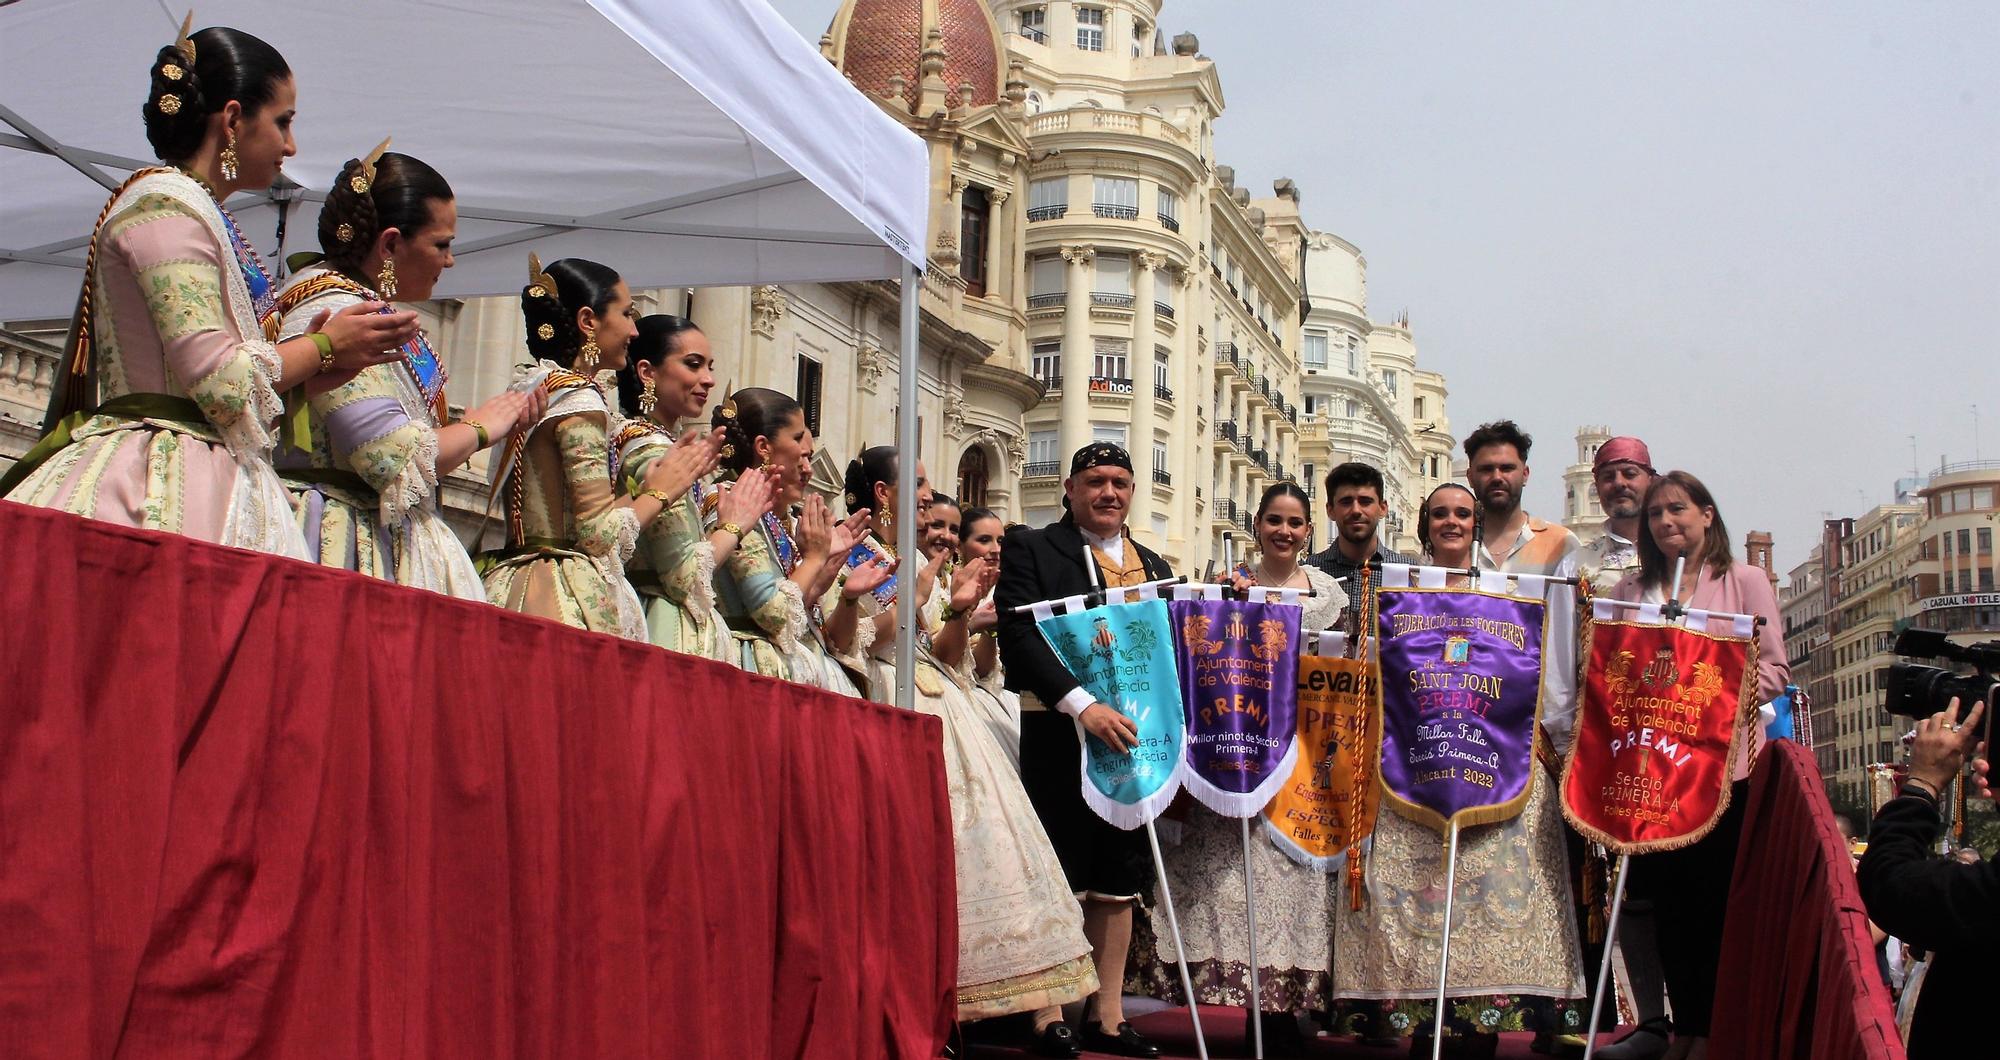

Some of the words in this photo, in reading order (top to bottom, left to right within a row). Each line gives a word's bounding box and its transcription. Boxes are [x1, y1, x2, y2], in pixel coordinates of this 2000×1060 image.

[1091, 380, 1132, 393] Adhoc
[1392, 612, 1446, 639] FEDERACIÓ
[1448, 617, 1459, 626] DE
[1461, 618, 1474, 627] LES
[1477, 617, 1526, 651] FOGUERES
[1196, 656, 1274, 673] Ajuntament
[1423, 660, 1435, 669] de
[1198, 673, 1217, 687] de
[1221, 672, 1271, 690] València
[1409, 670, 1452, 693] SANT
[1458, 673, 1503, 700] JOAN
[1200, 694, 1268, 727] PREMI
[1418, 691, 1492, 719] PREMI
[1442, 711, 1448, 719] a
[1453, 710, 1462, 719] la
[1612, 695, 1701, 719] Ajuntament
[1416, 724, 1454, 742] Millor
[1458, 723, 1487, 746] Falla
[1611, 714, 1630, 727] de
[1635, 713, 1698, 737] València
[1188, 733, 1216, 745] Millor
[1218, 732, 1244, 742] ninot
[1245, 733, 1255, 743] de
[1610, 727, 1692, 767] PREMI
[1438, 741, 1499, 769] Primera-A
[1414, 765, 1456, 785] Alacant
[1463, 768, 1493, 788] 2022
[1616, 772, 1662, 791] Secció
[1602, 786, 1679, 812] PRIMERA-A
[1603, 806, 1631, 816] Falles
[1634, 808, 1669, 826] 2022
[1293, 826, 1321, 841] Falles
